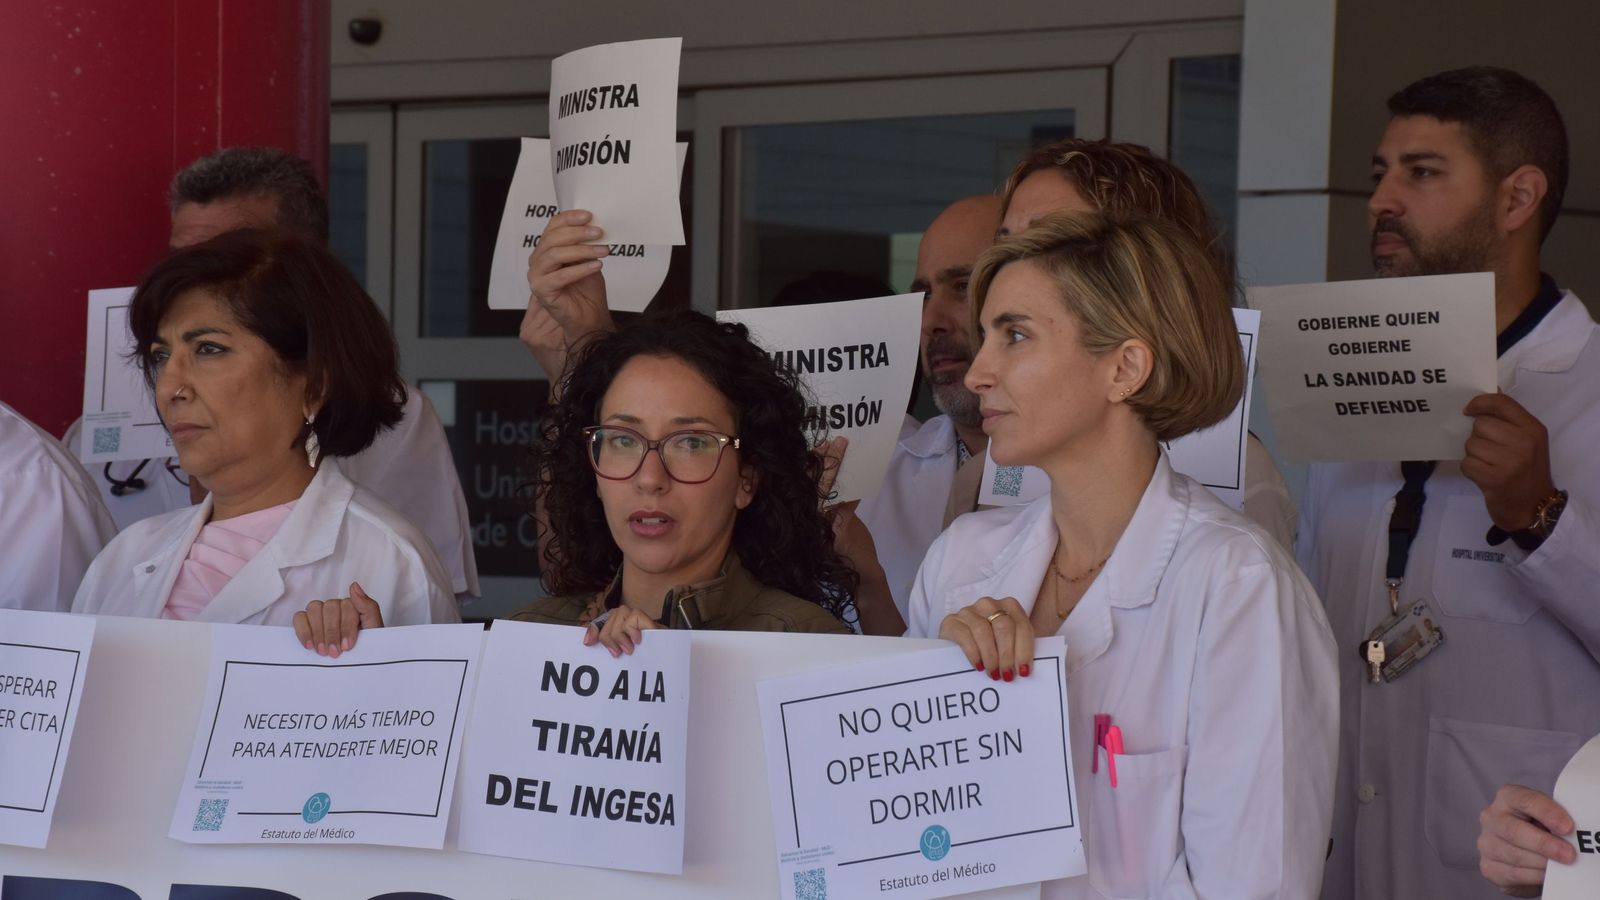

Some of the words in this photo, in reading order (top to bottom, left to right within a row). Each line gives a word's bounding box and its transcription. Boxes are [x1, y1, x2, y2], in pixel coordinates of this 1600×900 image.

[558, 84, 639, 119] MINISTRA
[556, 135, 630, 174] DIMISIÓN
[525, 204, 560, 219] HOR
[607, 244, 645, 258] ZADA
[1298, 315, 1380, 331] GOBIERNE
[1386, 311, 1439, 327] QUIEN
[766, 341, 890, 375] MINISTRA
[1328, 340, 1411, 355] GOBIERNE
[1304, 373, 1328, 388] LA
[1333, 371, 1416, 387] SANIDAD
[1422, 369, 1447, 384] SE
[801, 396, 882, 431] MISIÓN
[1335, 400, 1430, 415] DEFIENDE
[541, 661, 599, 696] NO
[609, 670, 628, 700] A
[639, 671, 665, 702] LA
[20, 712, 57, 733] CITA
[244, 714, 327, 730] NECESITO
[332, 710, 367, 729] MÁS
[372, 710, 434, 727] TIEMPO
[839, 708, 881, 737] NO
[891, 687, 1000, 732] QUIERO
[232, 742, 275, 757] PARA
[280, 740, 376, 758] ATENDERTE
[380, 739, 438, 758] MEJOR
[532, 719, 661, 763] TIRANÍA
[826, 738, 969, 785] OPERARTE
[979, 729, 1022, 760] SIN
[486, 774, 558, 813] DEL
[570, 785, 674, 826] INGESA
[869, 783, 982, 825] DORMIR
[261, 829, 301, 839] Estatuto
[304, 828, 318, 838] del
[320, 828, 354, 838] Médico
[880, 872, 928, 891] Estatuto
[932, 863, 950, 882] del
[953, 861, 996, 879] Médico
